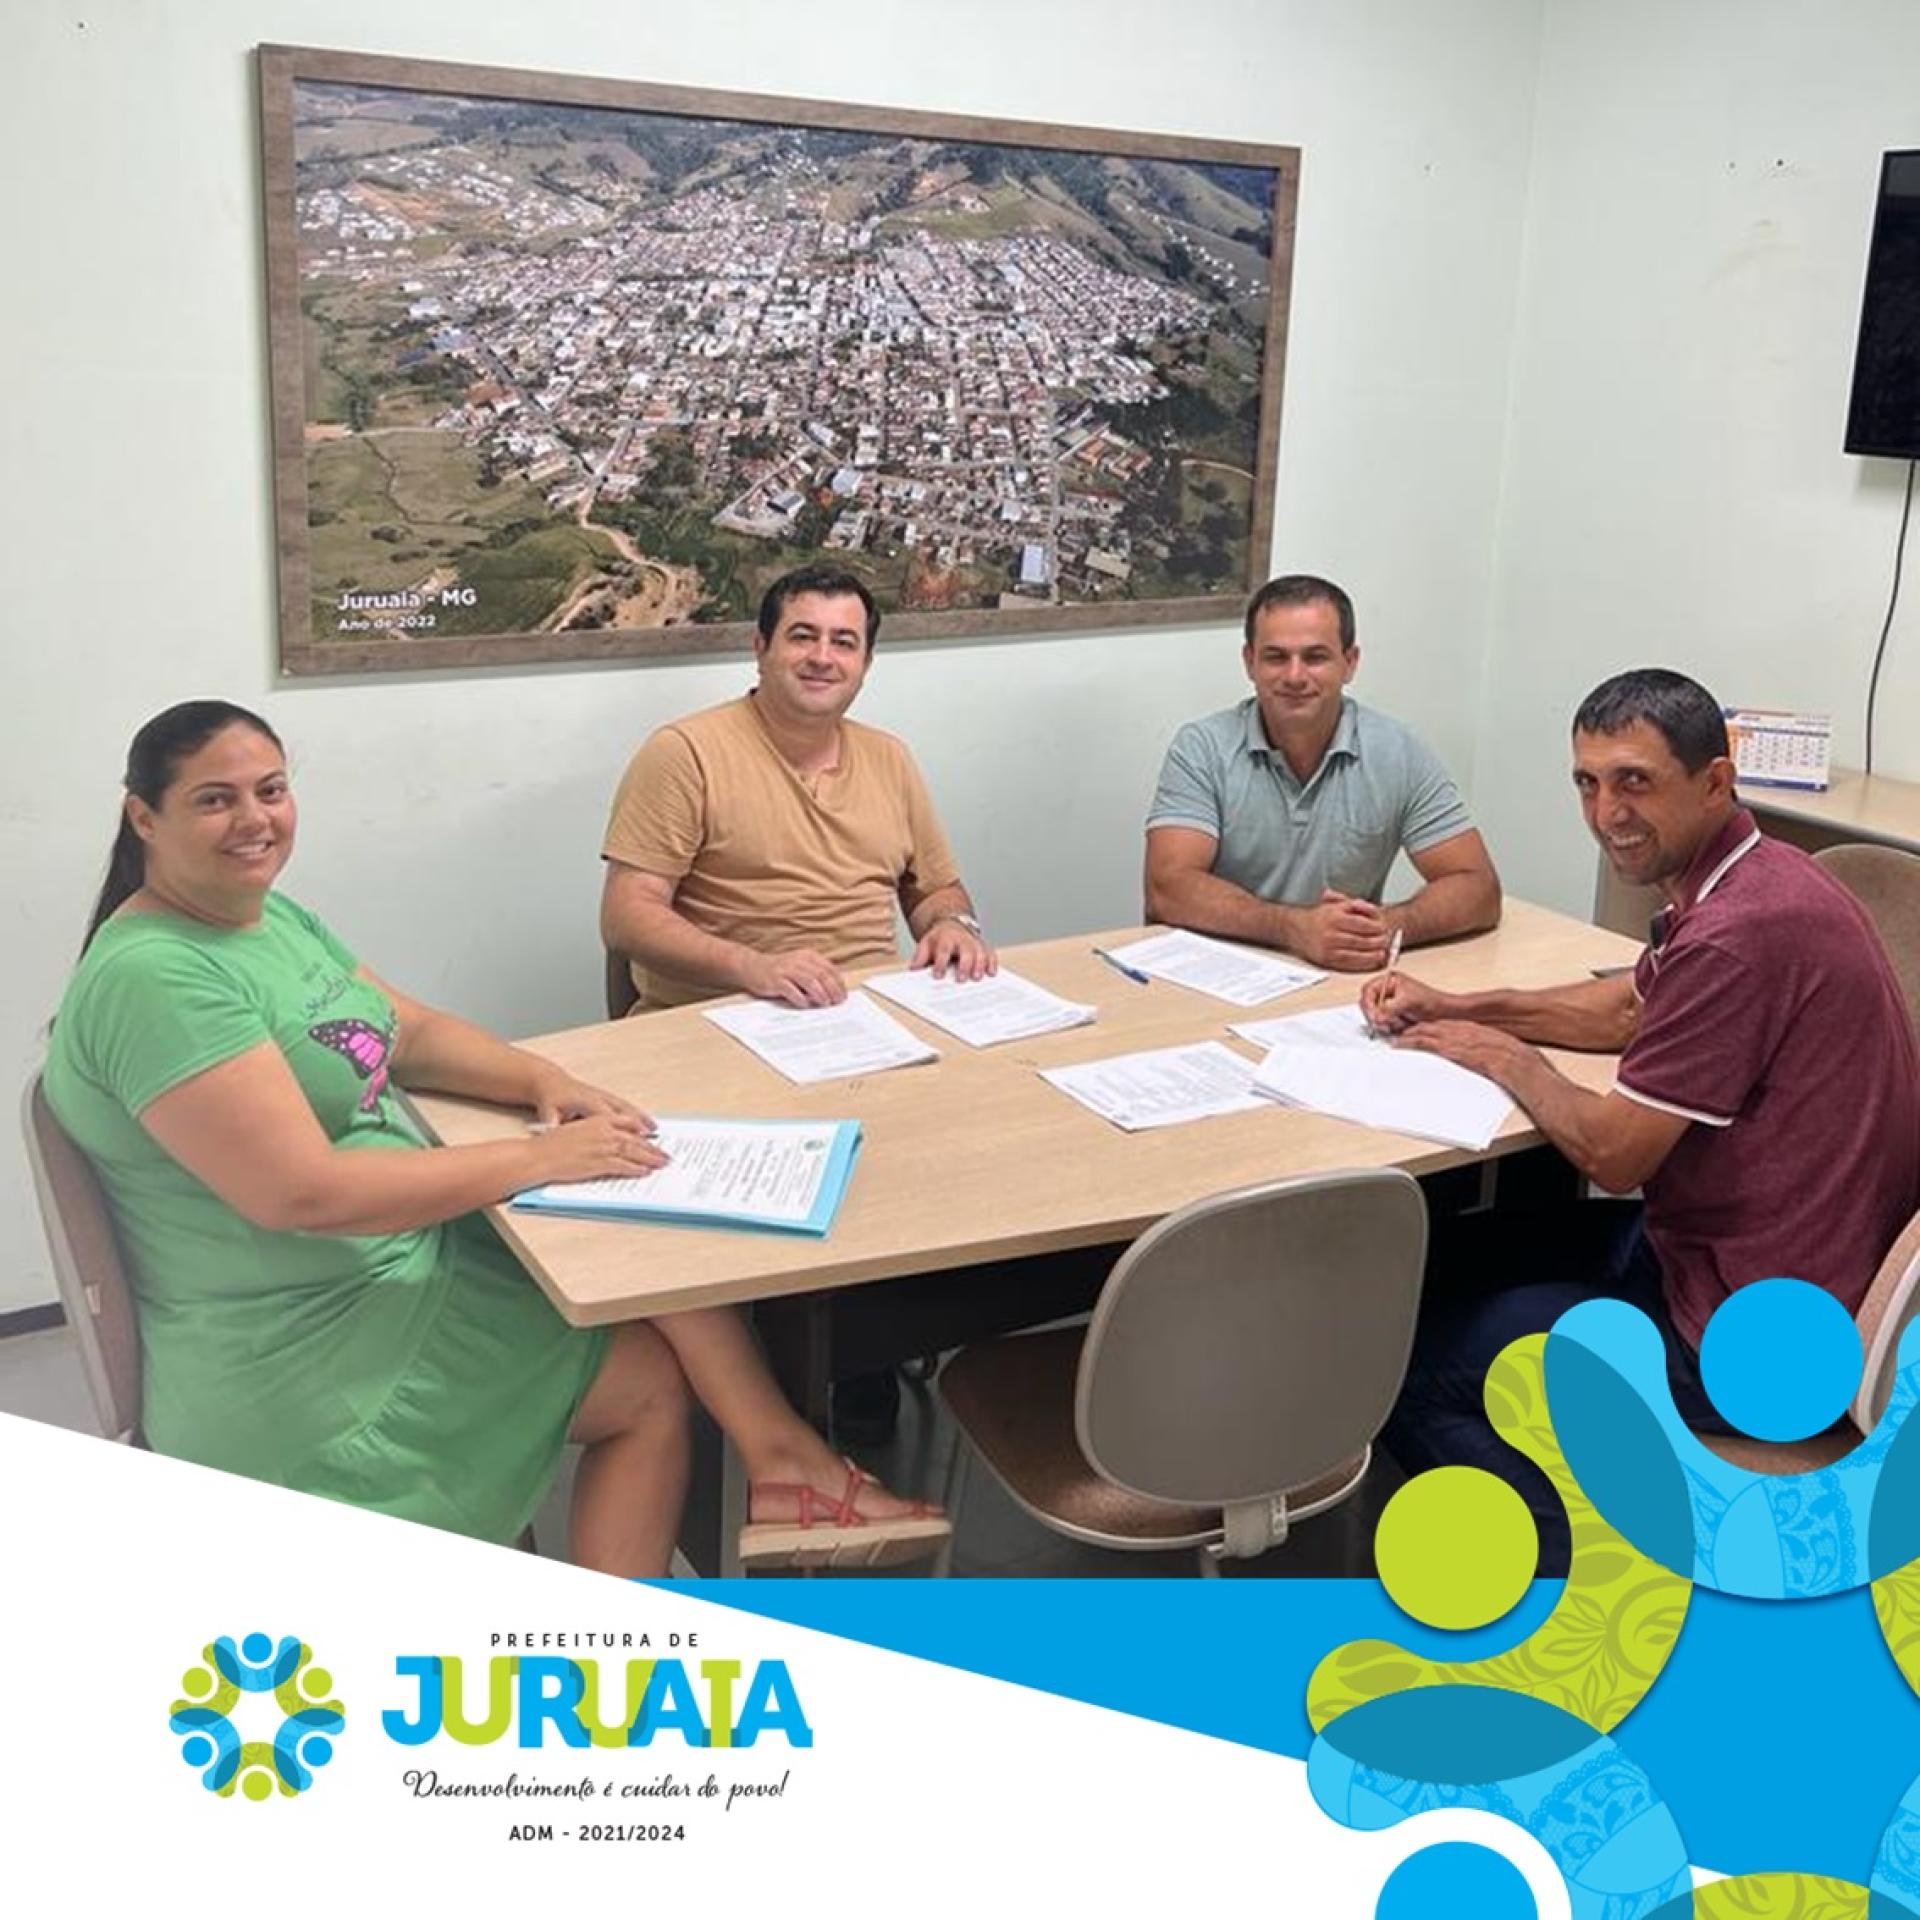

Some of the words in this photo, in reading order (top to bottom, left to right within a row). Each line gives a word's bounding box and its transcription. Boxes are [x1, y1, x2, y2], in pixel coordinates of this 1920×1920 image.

[338, 590, 420, 611] Juruaia
[441, 588, 477, 607] MG
[338, 619, 370, 631] Ano
[374, 618, 392, 630] de
[398, 614, 436, 629] 2022
